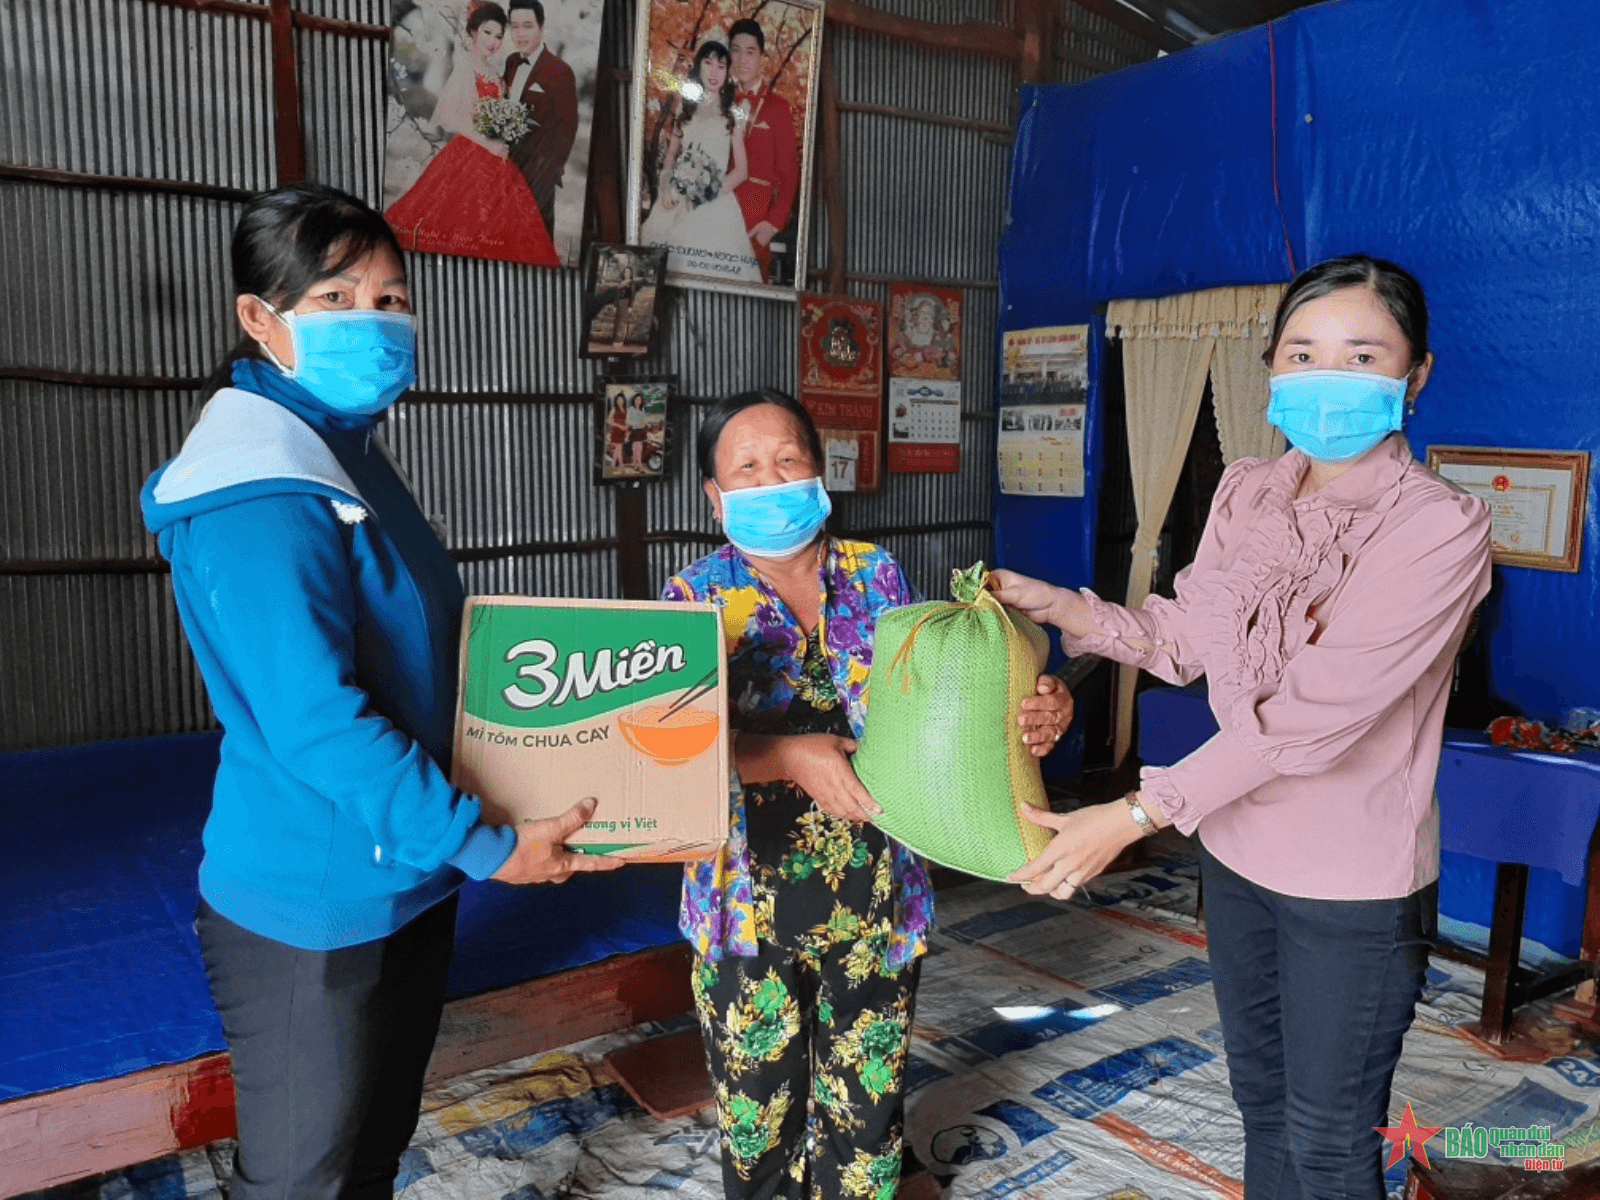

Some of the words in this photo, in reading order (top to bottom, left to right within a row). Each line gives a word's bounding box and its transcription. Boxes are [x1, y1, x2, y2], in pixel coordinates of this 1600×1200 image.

[831, 460, 849, 479] 17
[502, 637, 560, 711] 3
[549, 638, 688, 707] Miền
[522, 733, 573, 748] CHUA
[575, 725, 610, 744] CAY
[620, 817, 631, 832] vị
[633, 817, 658, 832] Việt
